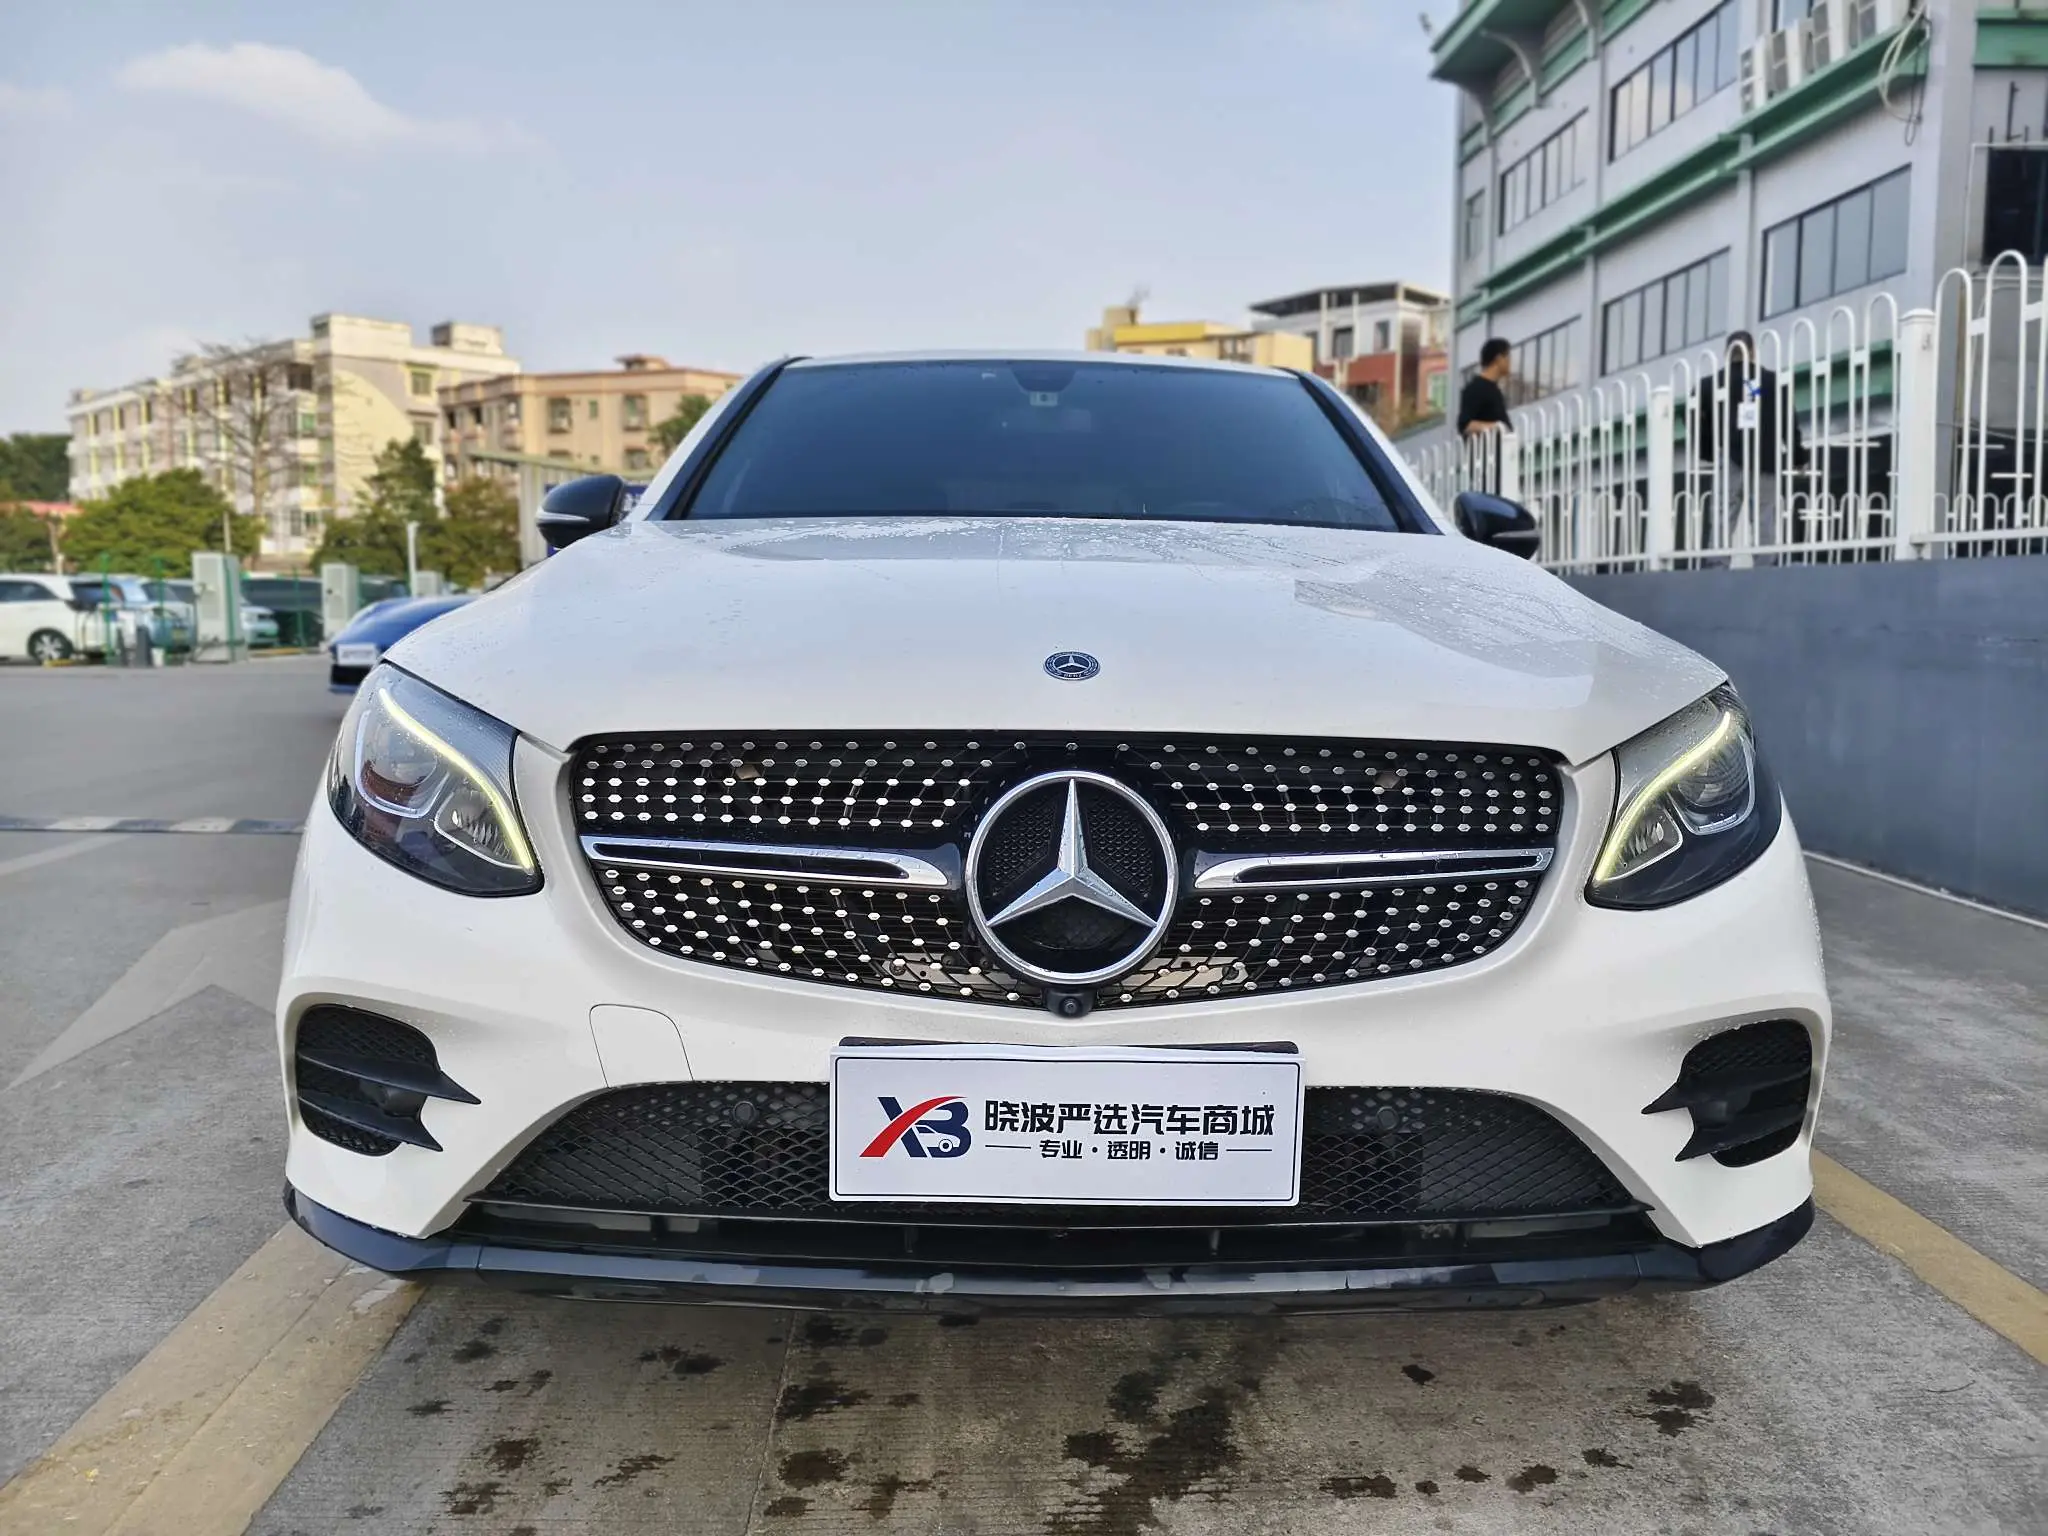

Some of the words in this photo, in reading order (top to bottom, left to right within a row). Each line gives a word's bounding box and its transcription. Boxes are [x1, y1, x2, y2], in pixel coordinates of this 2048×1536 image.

[985, 1101, 1275, 1136] 晓波严选汽车商城
